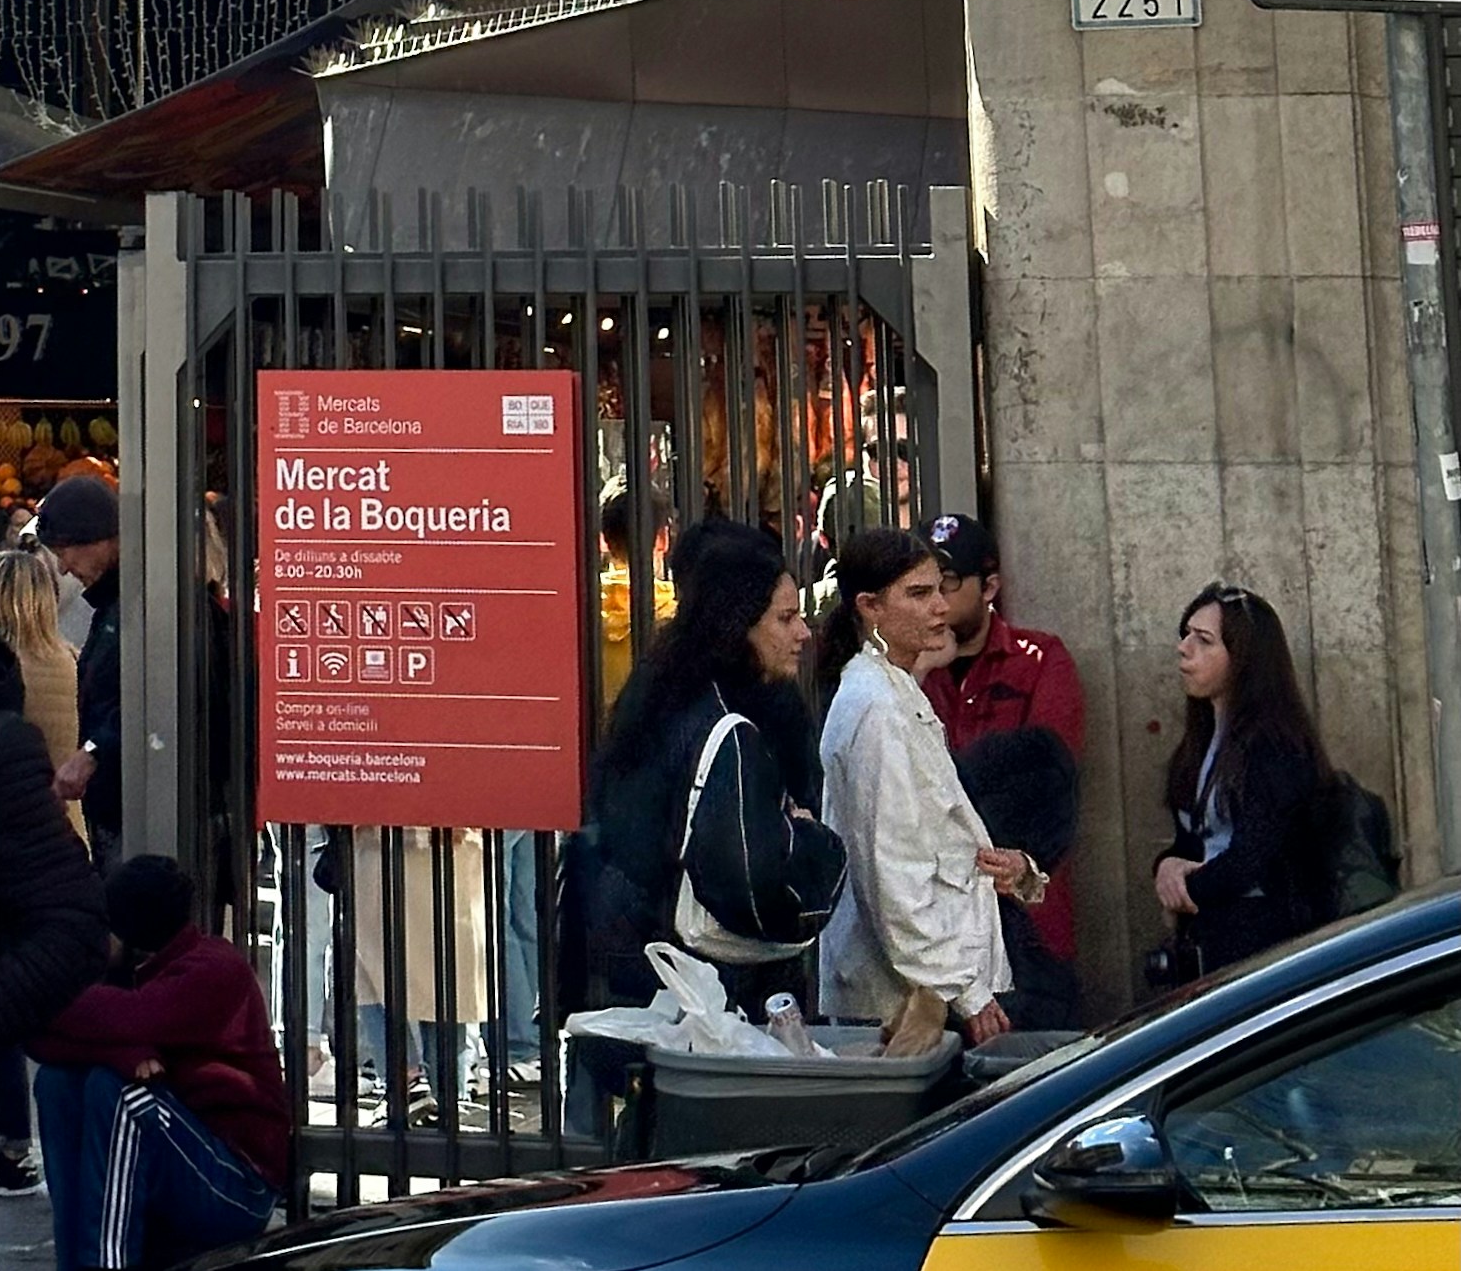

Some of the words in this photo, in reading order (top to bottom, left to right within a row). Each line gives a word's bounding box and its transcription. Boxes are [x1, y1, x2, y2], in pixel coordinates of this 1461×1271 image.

[317, 395, 380, 413] Mercats
[317, 417, 339, 434] de
[343, 417, 422, 435] Barcelona
[275, 458, 391, 491] Mercat
[274, 498, 315, 530] de
[323, 497, 351, 531] la
[360, 498, 511, 538] Boqueria
[275, 548, 292, 564] De
[340, 552, 348, 564] a
[350, 549, 402, 564] dissabte
[275, 701, 323, 717] Compra
[326, 703, 370, 716] on-line
[275, 718, 314, 732] Servei
[317, 721, 325, 732] a
[328, 718, 378, 733] domicili
[275, 752, 426, 768] www.boqueria.barcelona
[275, 767, 421, 784] www.mercats.barcelona
